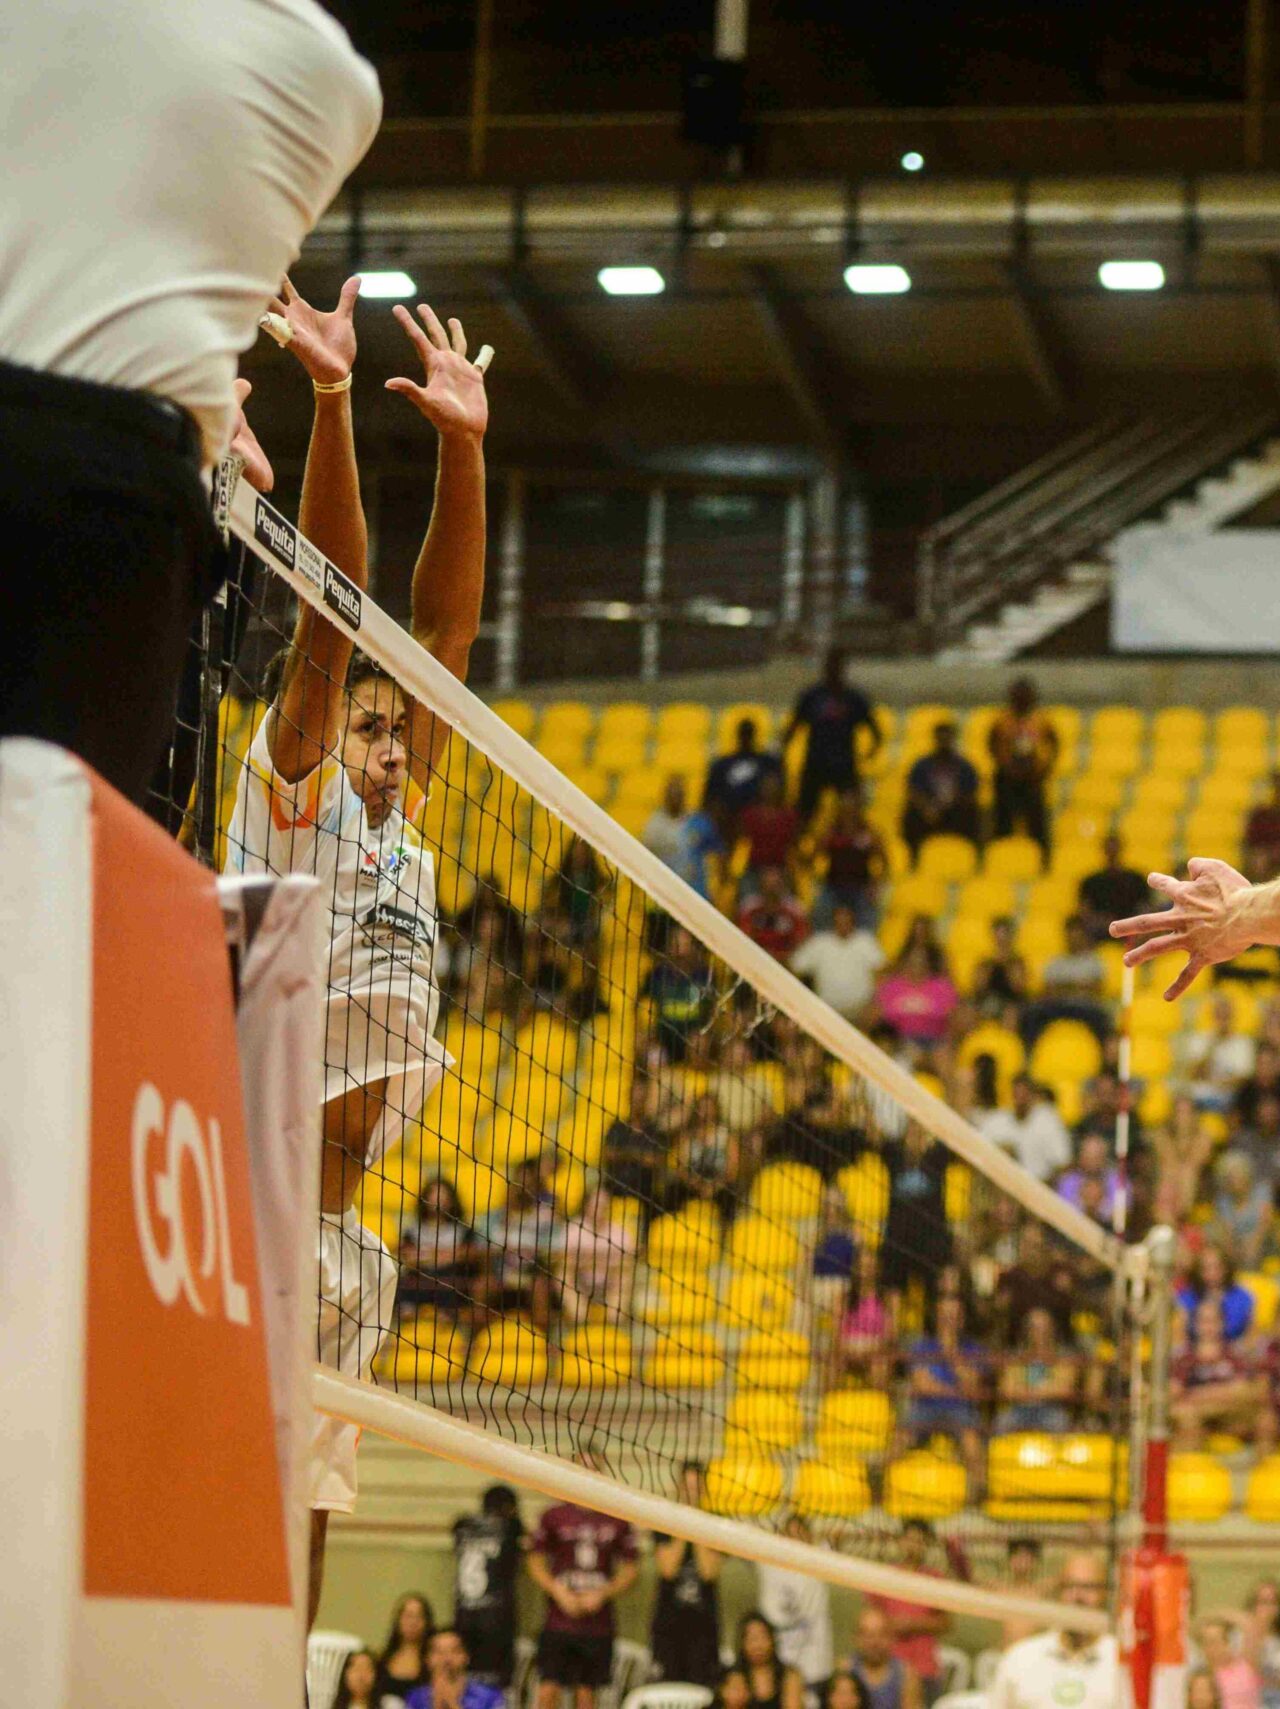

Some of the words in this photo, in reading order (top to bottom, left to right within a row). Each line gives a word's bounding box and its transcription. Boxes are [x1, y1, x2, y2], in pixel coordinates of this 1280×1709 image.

[257, 504, 295, 556] Pequita
[326, 569, 361, 616] Pequita
[131, 1081, 251, 1327] GOL
